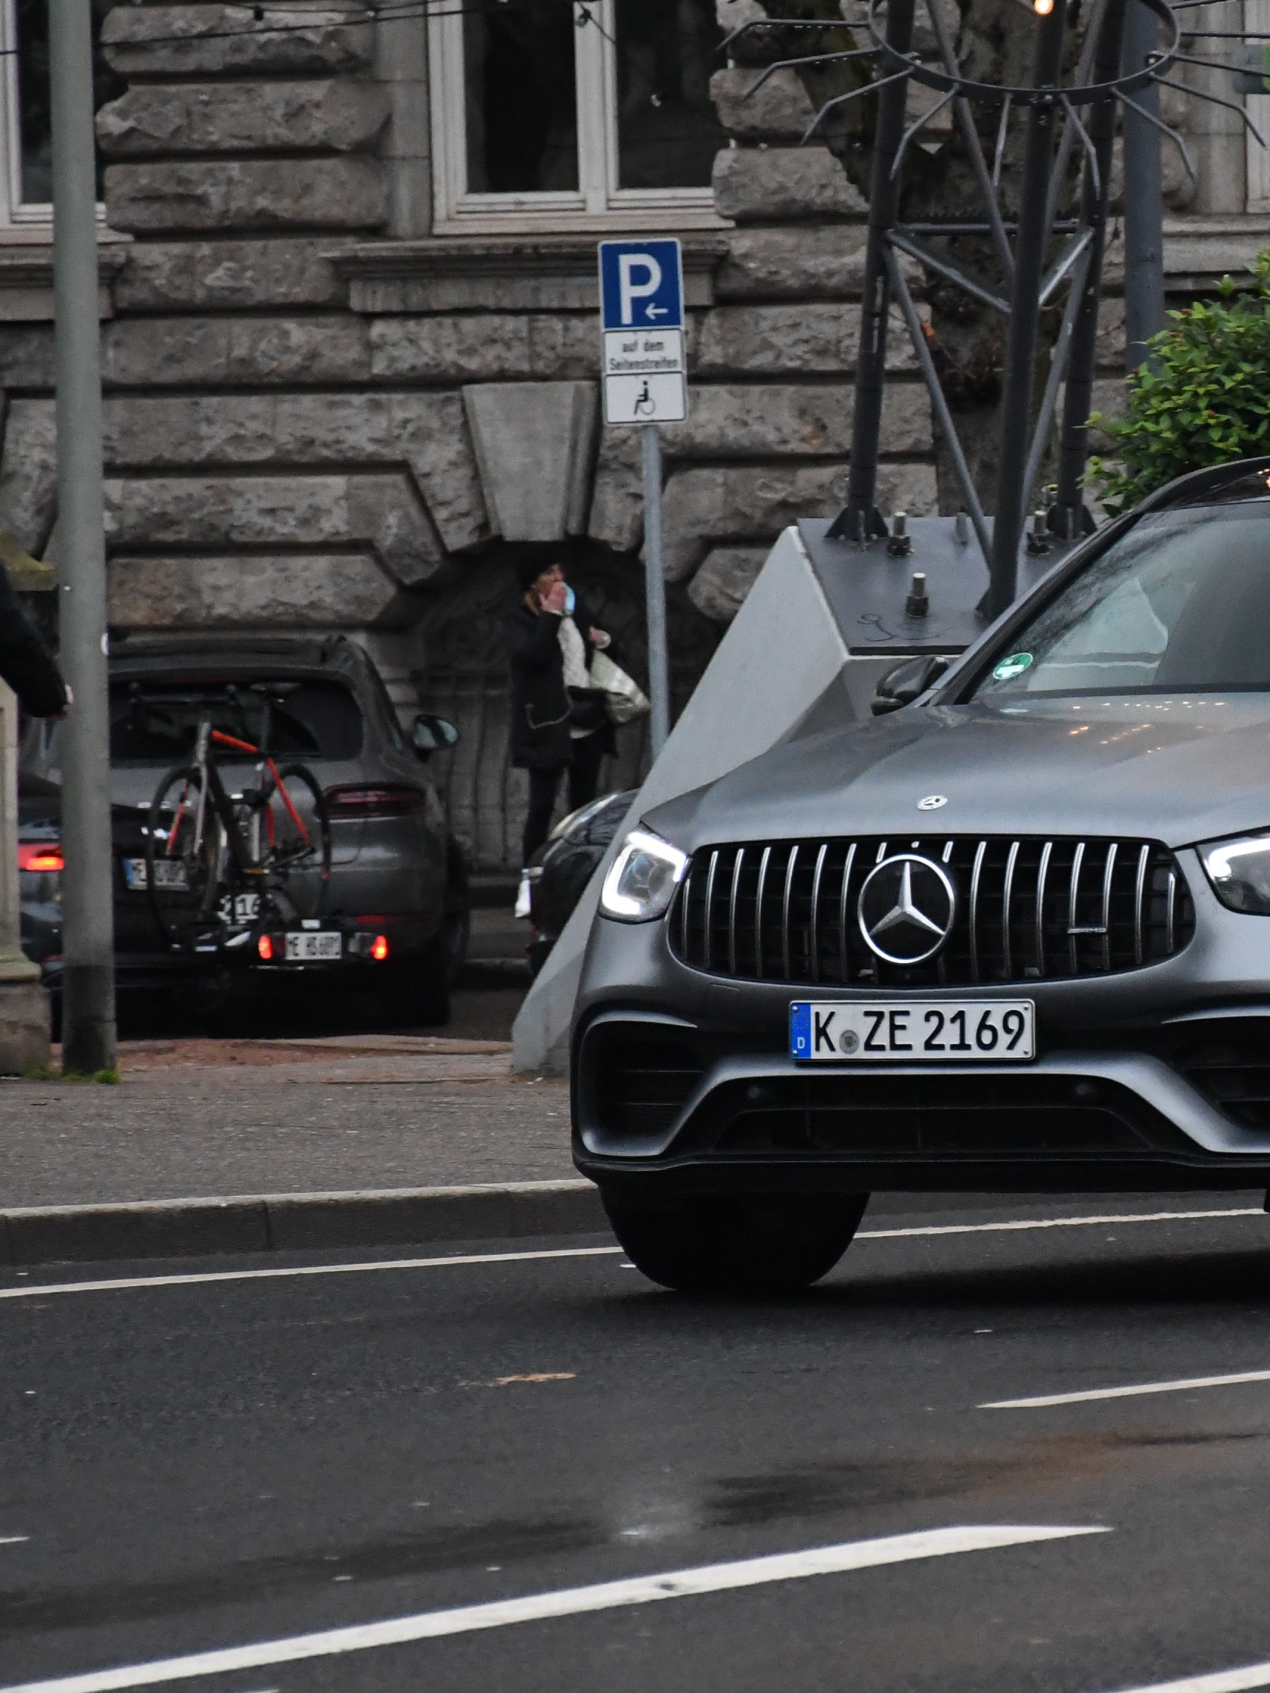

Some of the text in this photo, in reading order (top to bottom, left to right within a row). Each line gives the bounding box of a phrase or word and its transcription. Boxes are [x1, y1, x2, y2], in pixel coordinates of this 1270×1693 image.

[618, 253, 662, 325] P
[609, 356, 679, 372] Seitenstreifen
[814, 1010, 837, 1053] K
[863, 1010, 913, 1052] ZE
[923, 1009, 1026, 1052] 2169
